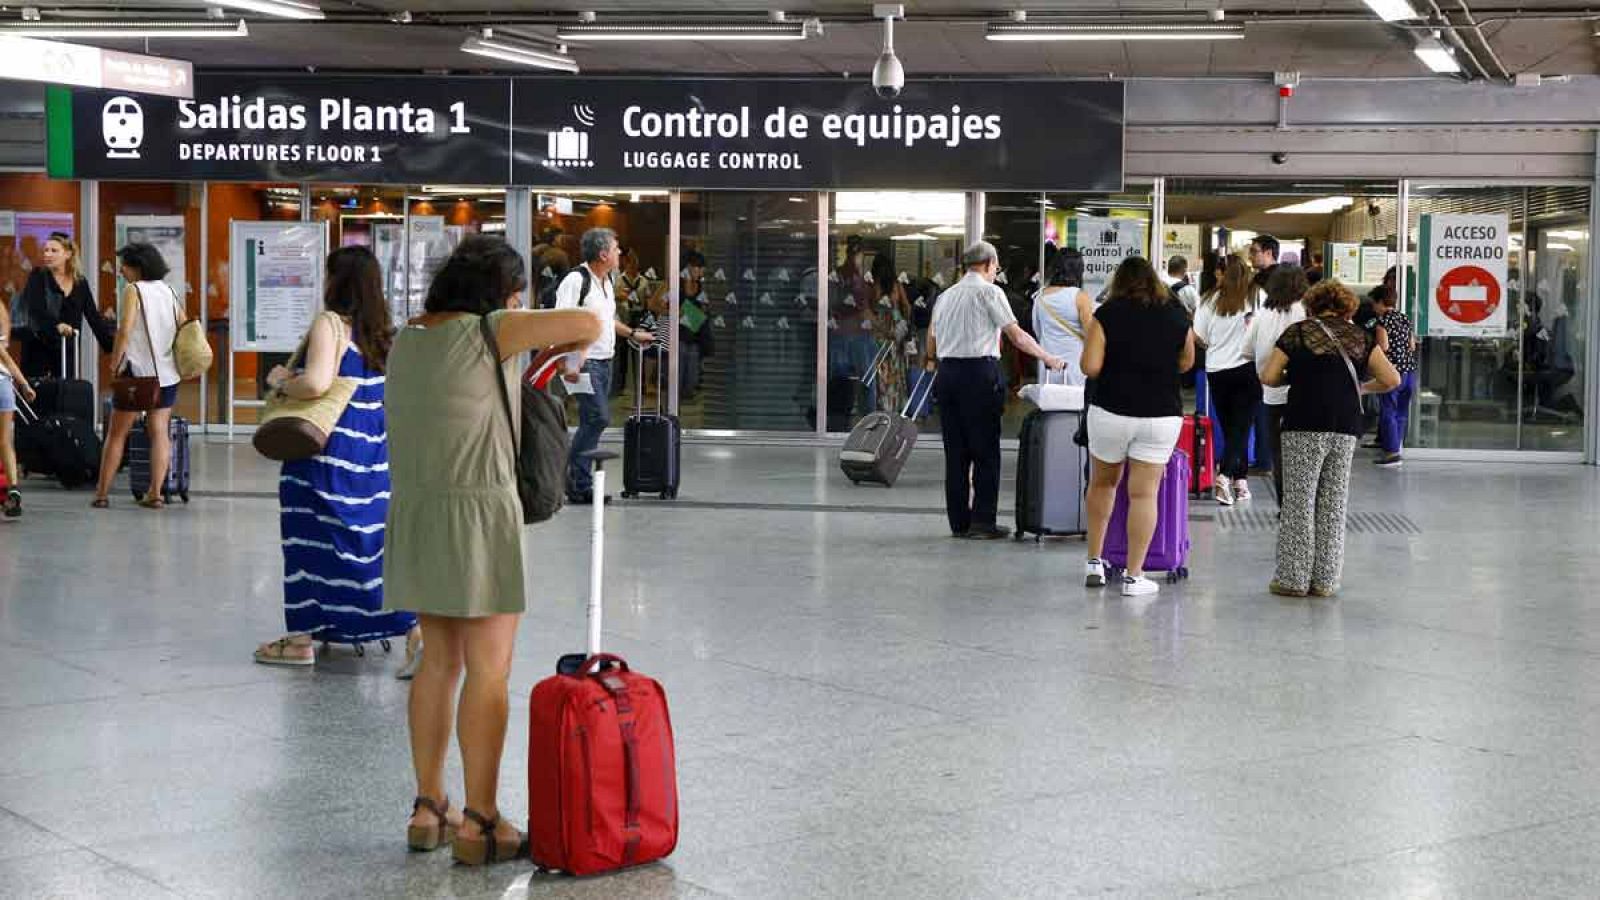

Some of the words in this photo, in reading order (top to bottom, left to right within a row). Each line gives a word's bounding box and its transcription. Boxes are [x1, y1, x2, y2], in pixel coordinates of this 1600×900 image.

[178, 95, 307, 130] Salidas
[319, 98, 435, 133] Planta
[450, 101, 471, 133] 1
[622, 105, 749, 139] Control
[763, 105, 809, 139] de
[821, 105, 1002, 147] equipajes
[178, 143, 301, 162] DEPARTURES
[306, 145, 365, 163] FLOOR
[370, 146, 383, 163] 1
[623, 151, 710, 169] LUGGAGE
[718, 153, 803, 170] CONTROL
[1443, 225, 1497, 240] ACCESO
[1079, 246, 1122, 257] Control
[1126, 246, 1141, 256] de
[1436, 245, 1504, 260] CERRADO
[1086, 261, 1121, 274] quipa
